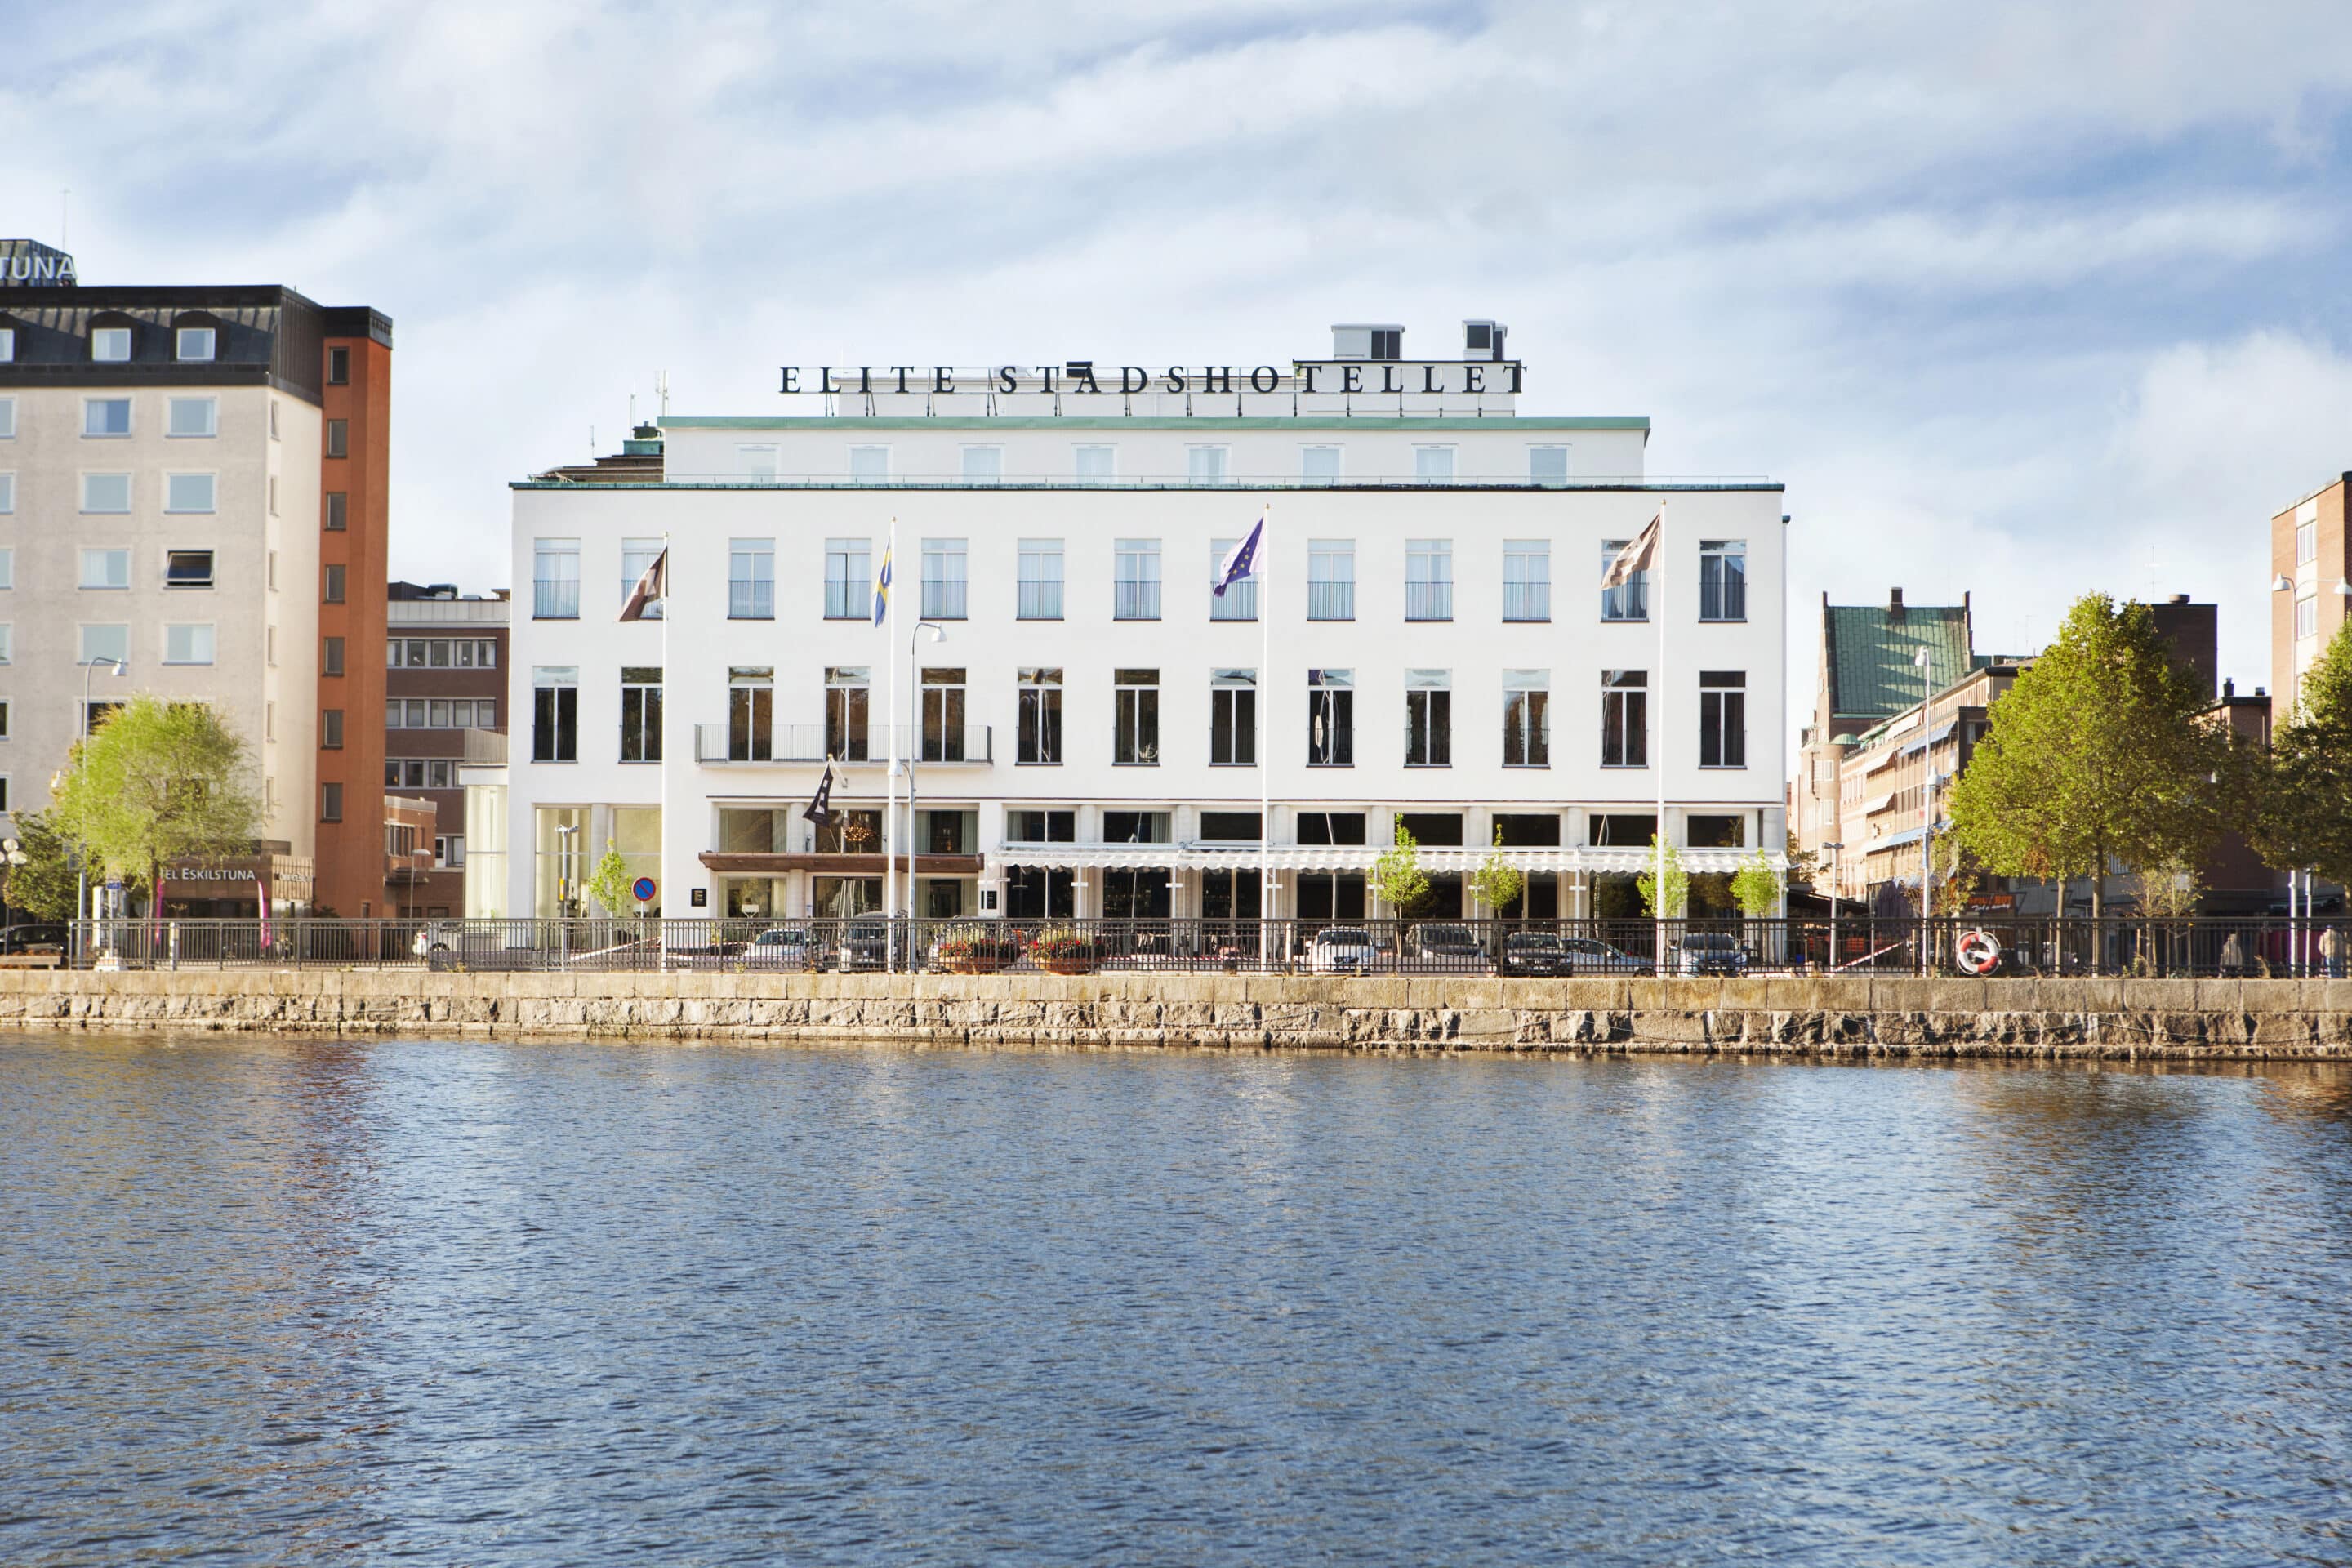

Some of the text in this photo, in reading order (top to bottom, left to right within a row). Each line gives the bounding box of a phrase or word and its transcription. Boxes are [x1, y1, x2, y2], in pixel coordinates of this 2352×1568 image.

[778, 365, 1528, 394] ELITE STADSHOTELLET
[181, 868, 256, 880] ESKILSTUNA
